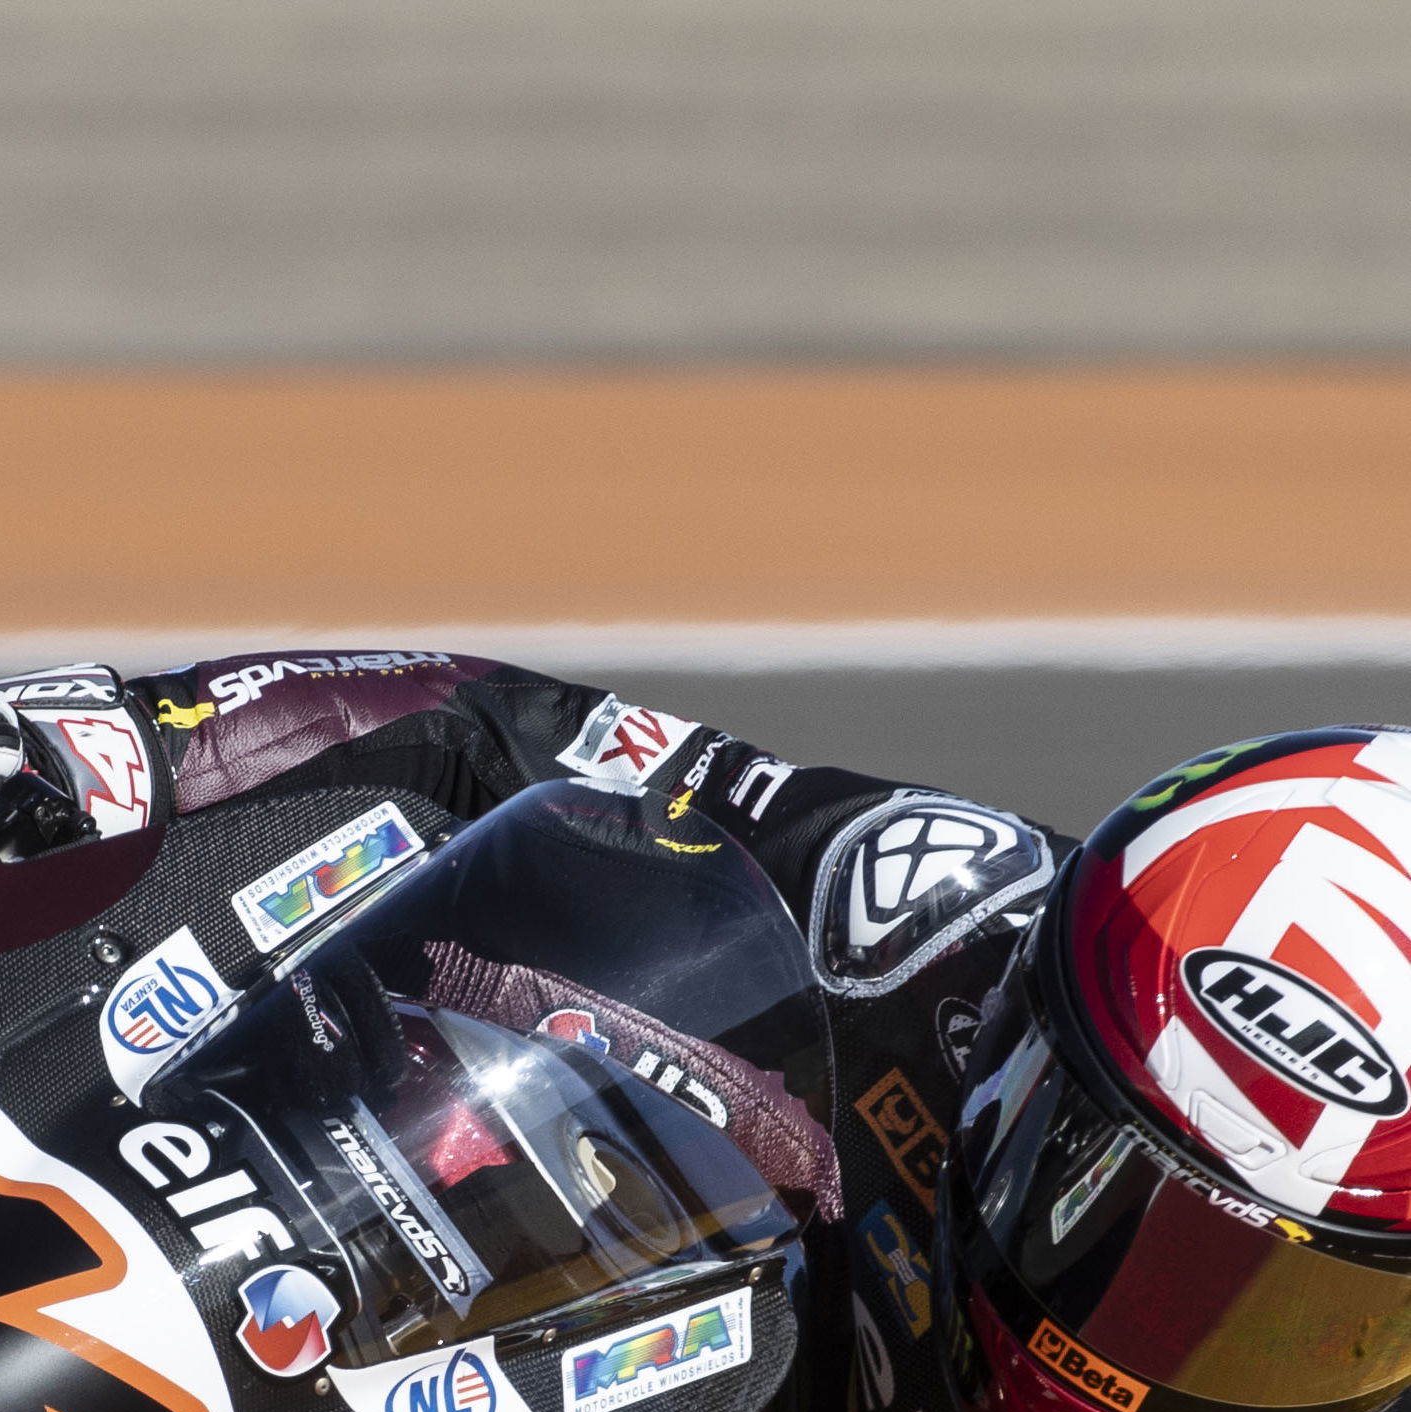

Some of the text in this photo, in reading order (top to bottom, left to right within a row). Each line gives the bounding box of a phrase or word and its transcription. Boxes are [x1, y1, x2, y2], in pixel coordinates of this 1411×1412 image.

[246, 806, 390, 899] MOTORCYCLE WINDSHIELDS
[256, 818, 413, 929] MRA
[120, 978, 160, 1013] GENEVA
[1202, 966, 1389, 1096] HJC
[1240, 1024, 1320, 1081] HELMETS
[118, 1121, 296, 1264] elf
[573, 1305, 733, 1401] MRA
[659, 1351, 736, 1388] WINDSHIELDS
[1059, 1346, 1134, 1409] Beta
